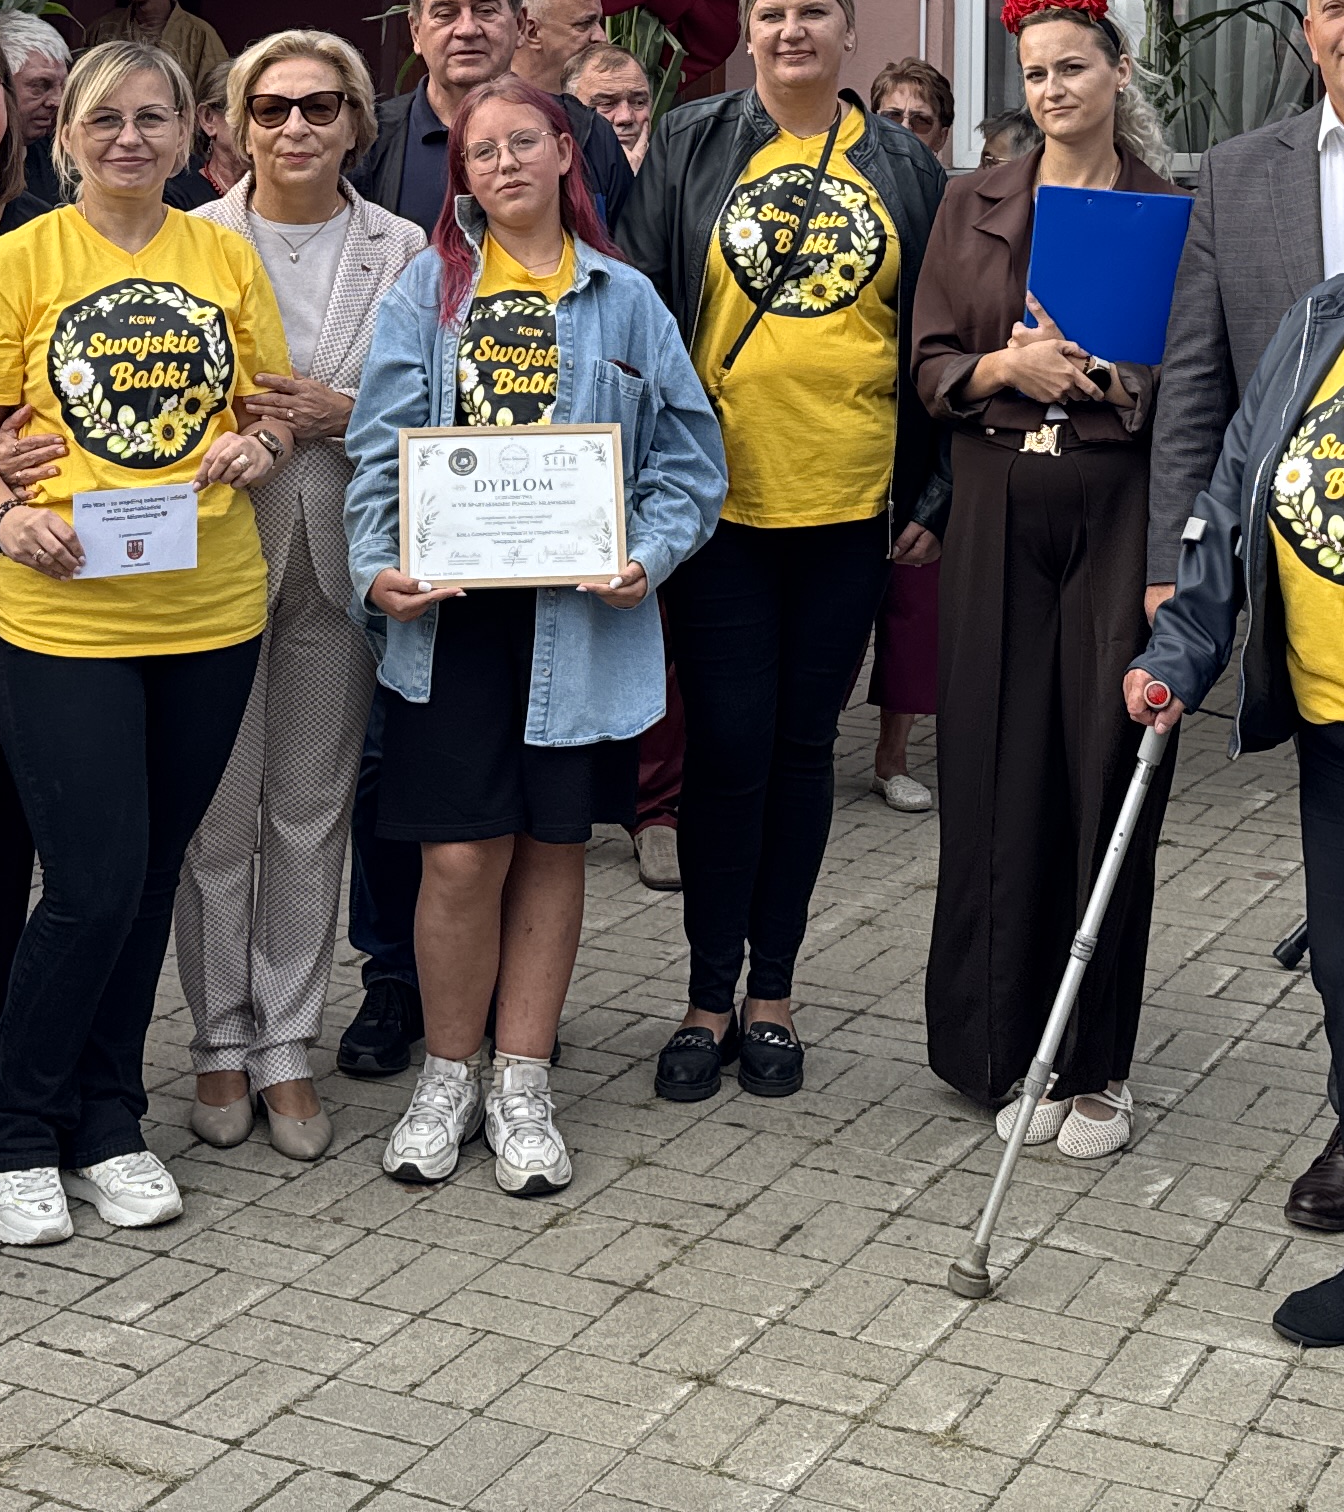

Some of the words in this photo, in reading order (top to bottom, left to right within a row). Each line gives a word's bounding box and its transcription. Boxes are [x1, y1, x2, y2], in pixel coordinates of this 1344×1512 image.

[774, 228, 839, 255] Bbki
[128, 315, 157, 325] KGW
[517, 325, 544, 337] KGW
[86, 329, 201, 361] Swojskie
[474, 335, 560, 371] Swojsk
[109, 362, 191, 392] Babki
[492, 368, 559, 396] Babk
[474, 478, 554, 493] DYPLOM
